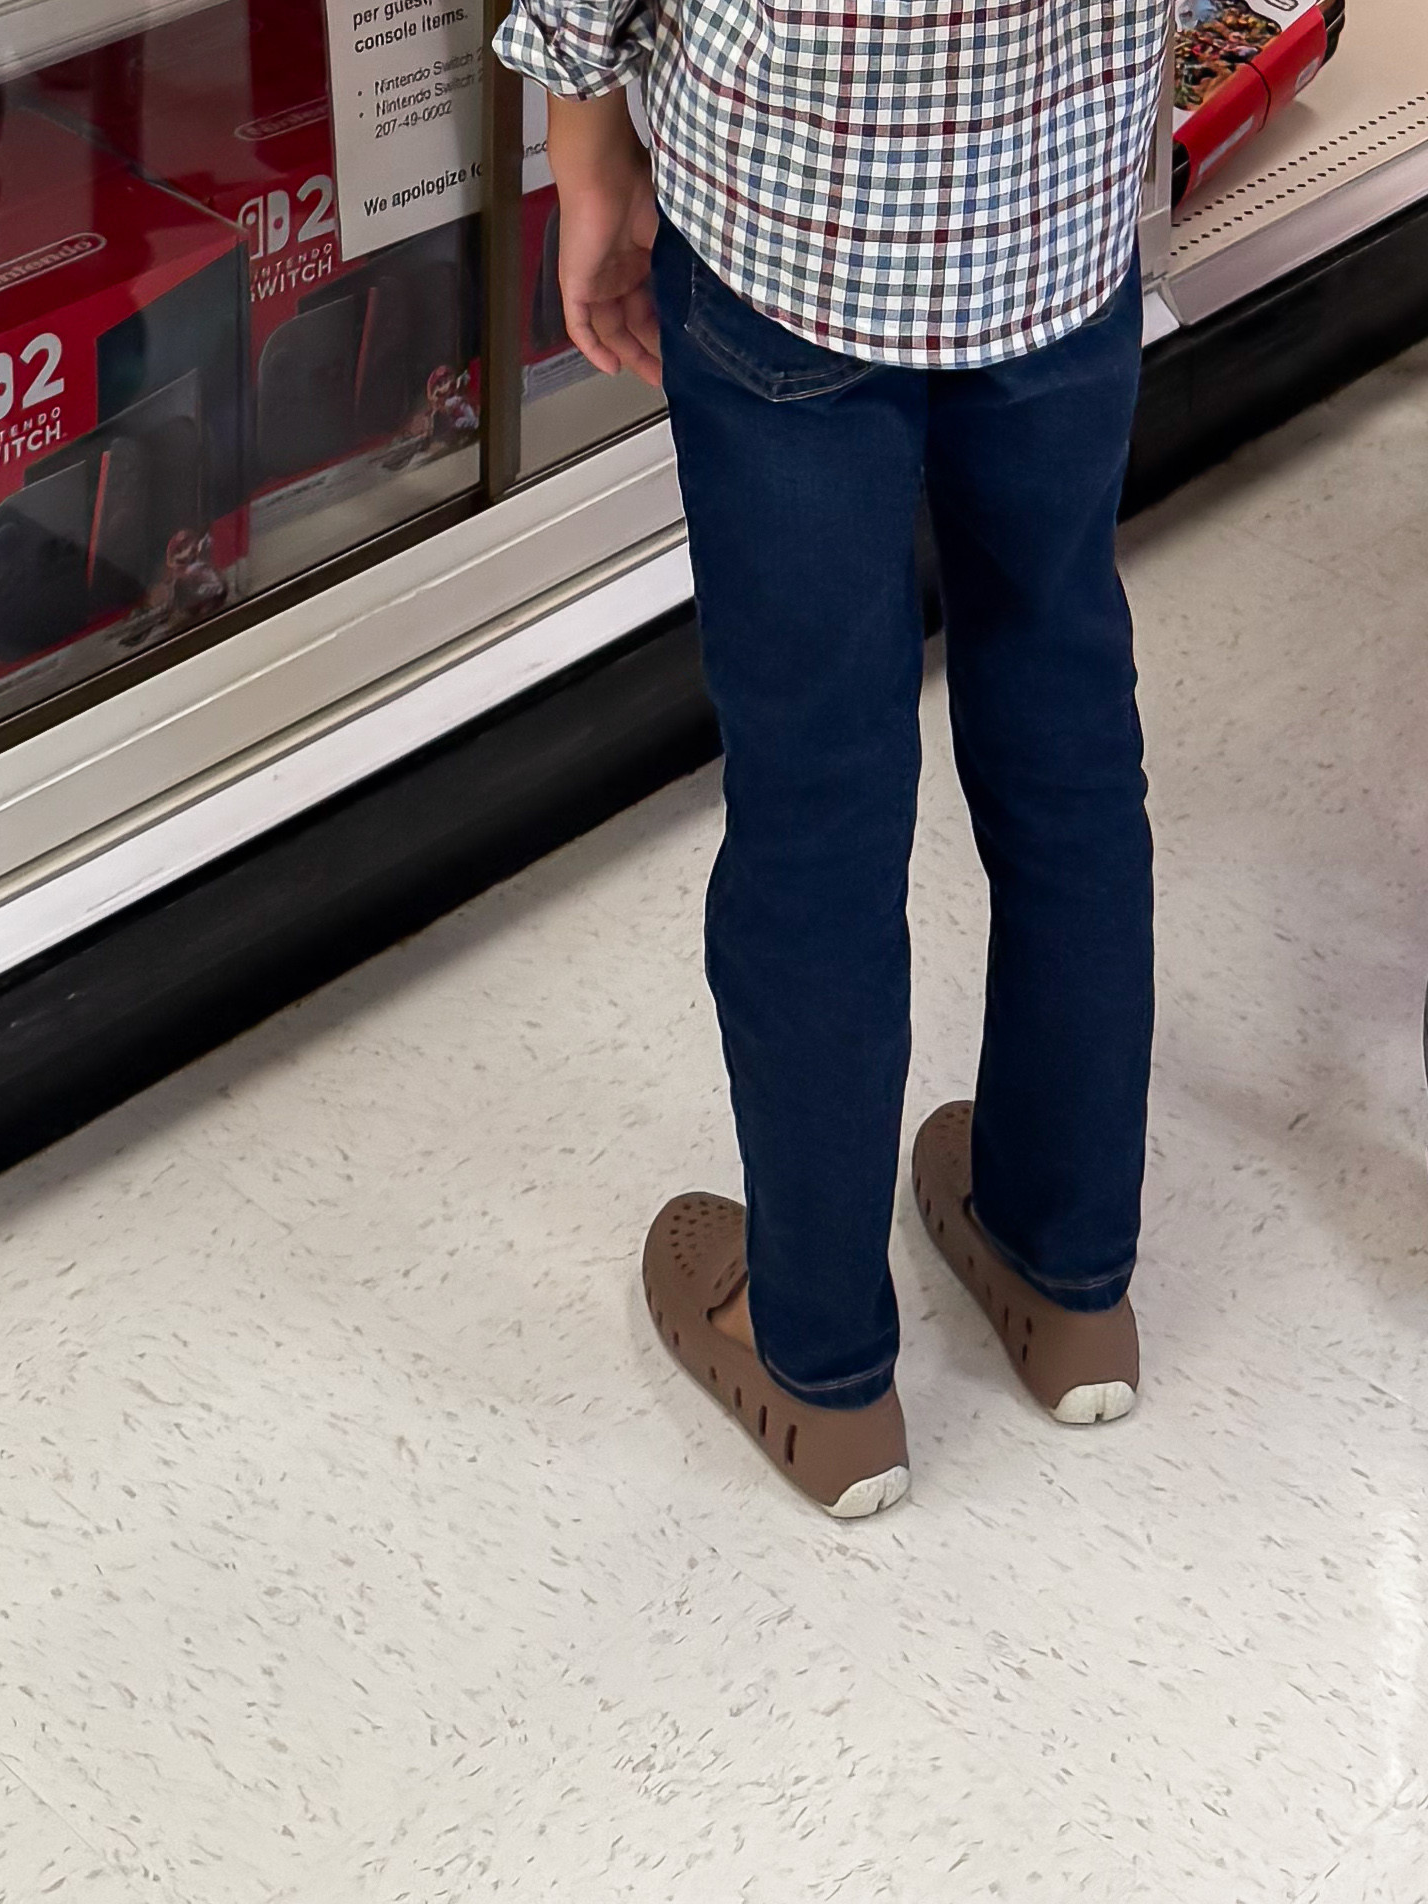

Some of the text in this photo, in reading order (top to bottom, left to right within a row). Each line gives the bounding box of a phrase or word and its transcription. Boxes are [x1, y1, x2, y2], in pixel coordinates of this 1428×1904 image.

[353, 9, 380, 31] per
[354, 21, 417, 54] console
[374, 60, 431, 96] Nintendo
[433, 51, 474, 76] Switch
[376, 82, 432, 118] Nintendo
[434, 72, 475, 97] Switch
[297, 174, 336, 242] 2
[364, 196, 388, 217] We
[391, 166, 467, 208] apologize
[20, 332, 65, 410] 2
